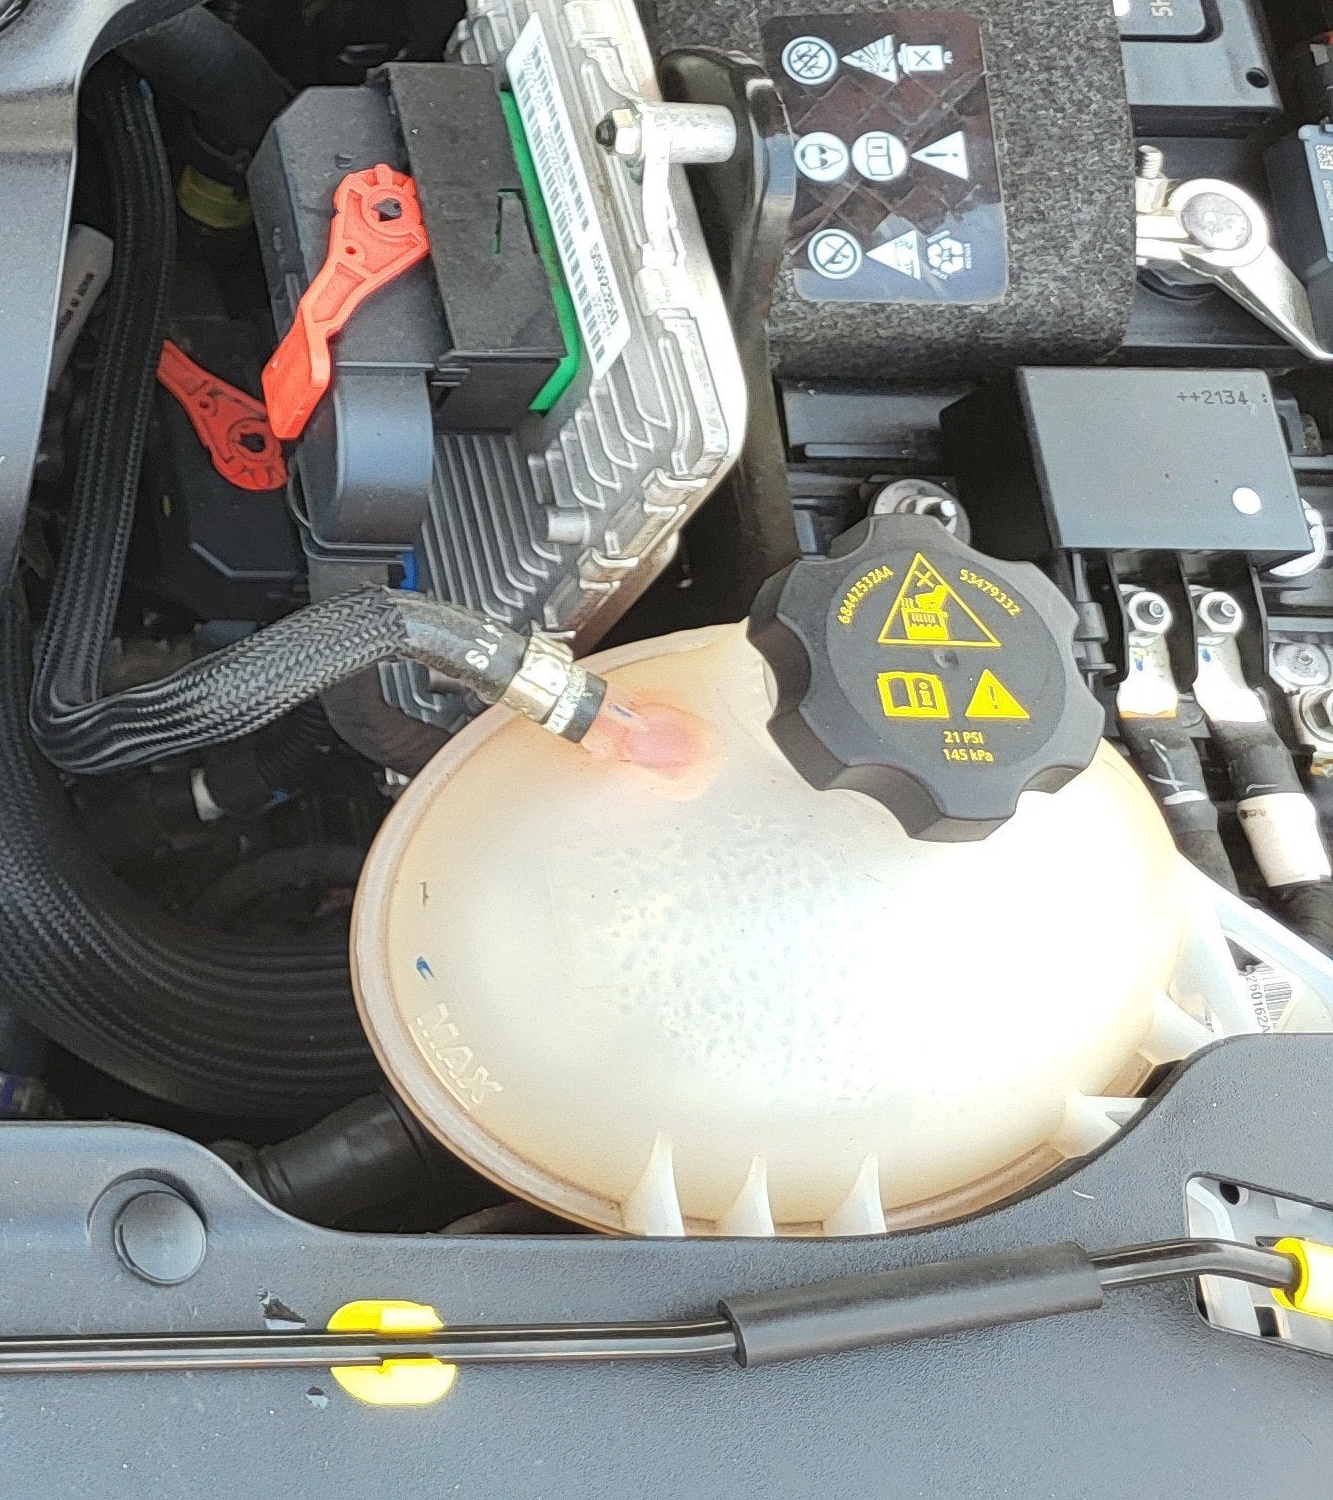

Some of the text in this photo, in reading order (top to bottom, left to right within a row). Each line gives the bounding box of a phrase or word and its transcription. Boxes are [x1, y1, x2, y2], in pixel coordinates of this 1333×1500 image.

[943, 730, 985, 745] 21 PSI
[943, 748, 994, 763] 145 kPa
